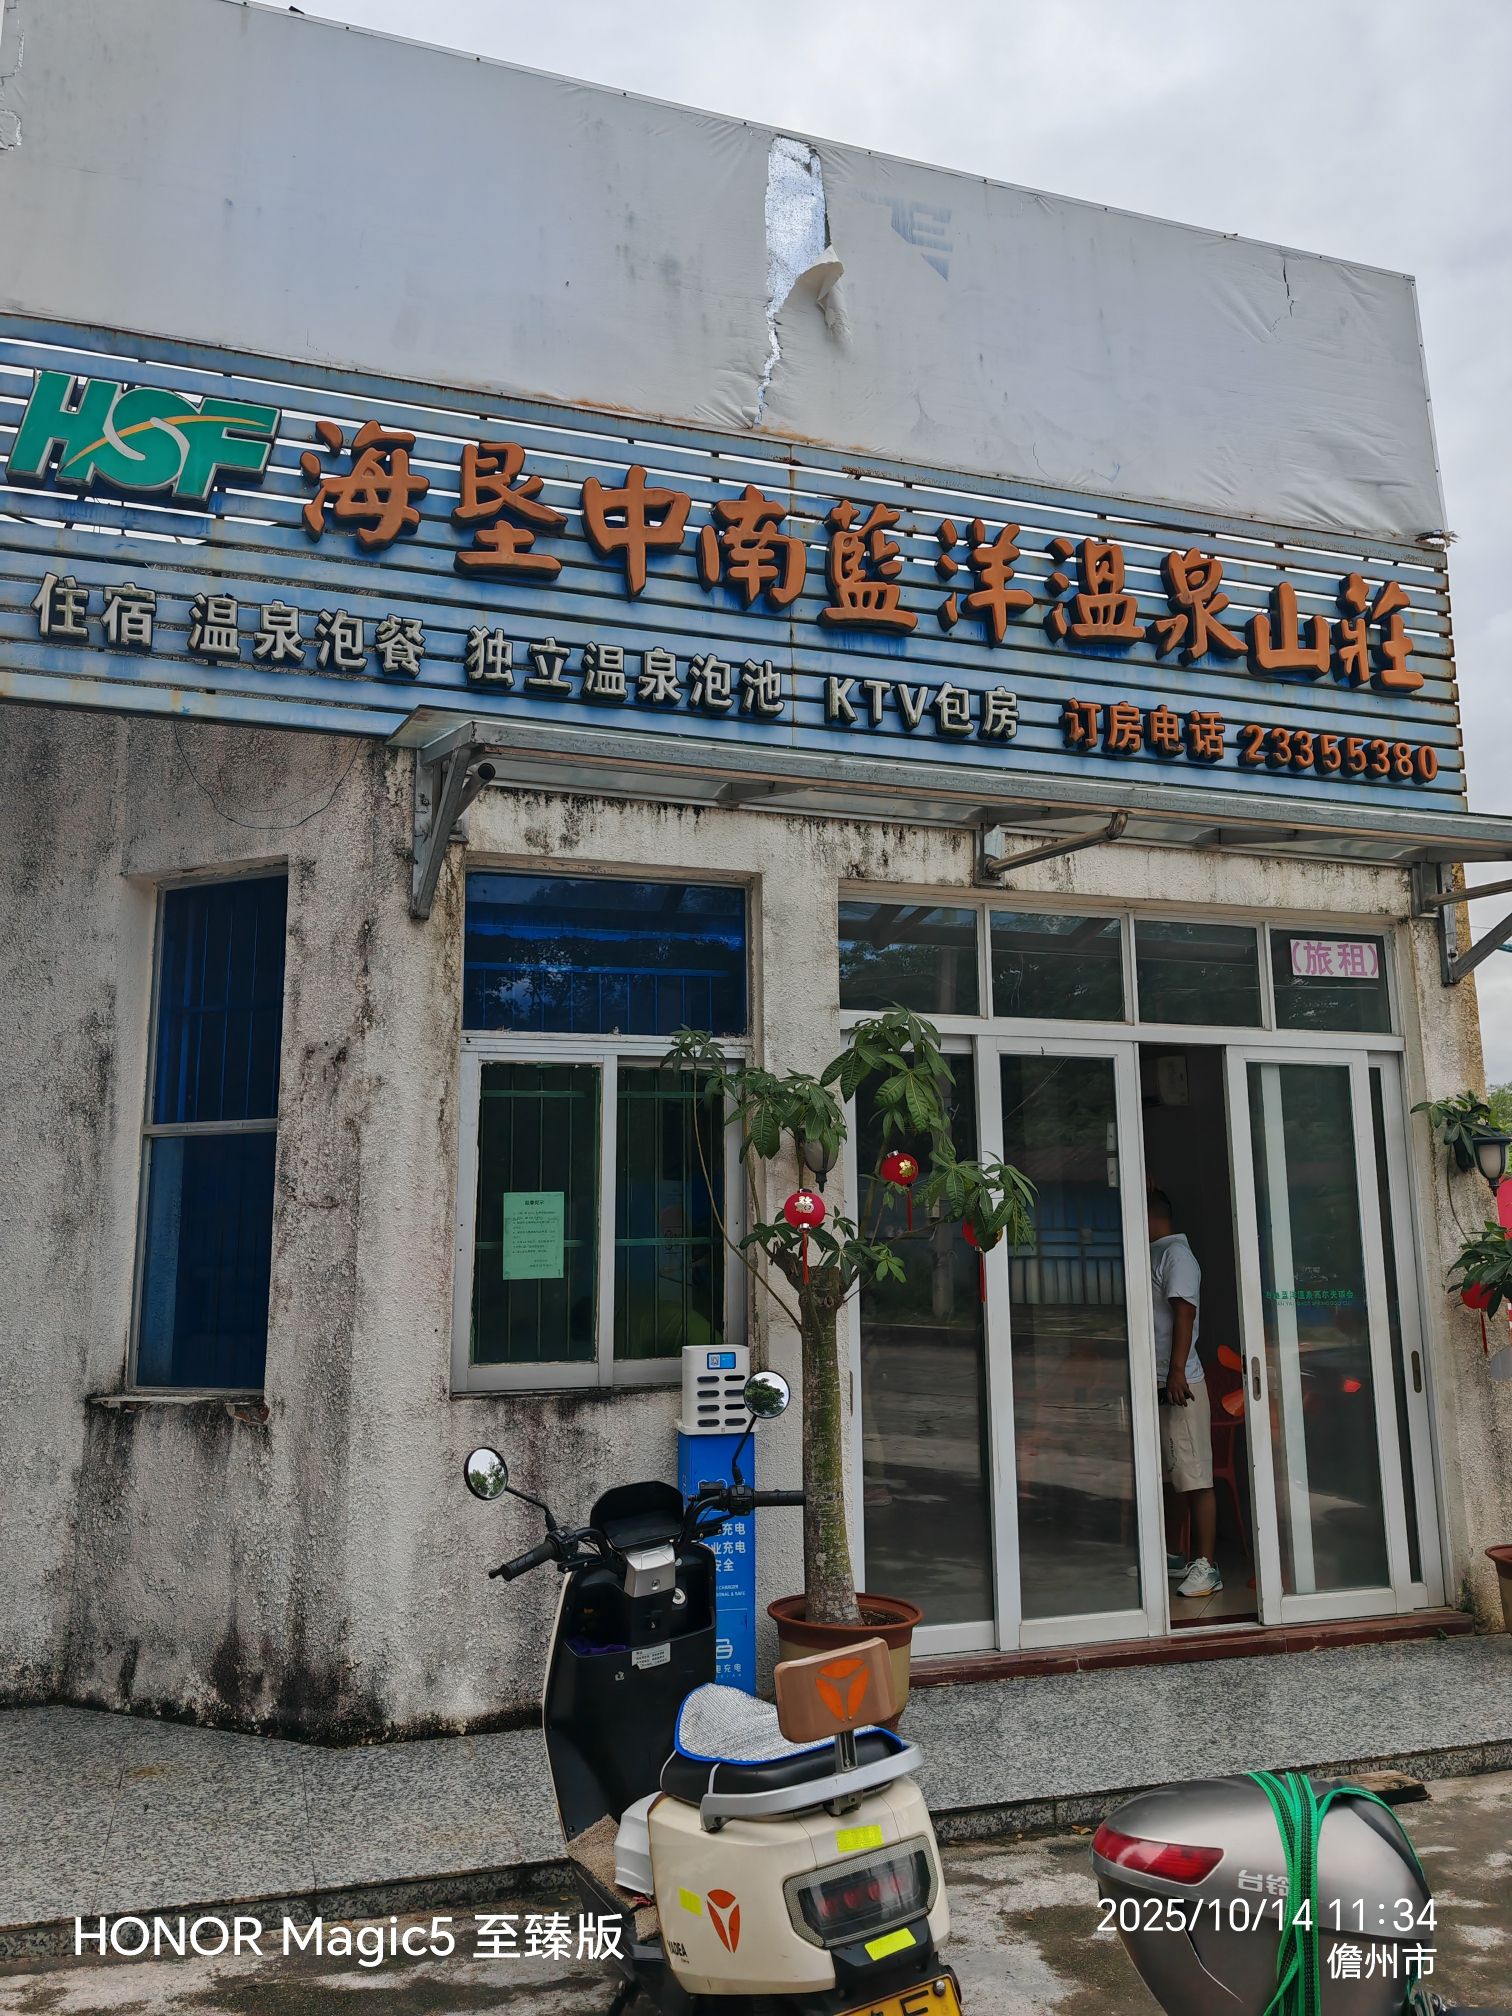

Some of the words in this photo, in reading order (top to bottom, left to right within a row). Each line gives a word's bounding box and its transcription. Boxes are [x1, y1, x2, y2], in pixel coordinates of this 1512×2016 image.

[31, 571, 156, 648] 住宿
[188, 592, 425, 677] 温泉泡餐
[465, 625, 785, 717] 独立温泉泡池
[824, 676, 1019, 741] KTV包房
[1062, 698, 1226, 764] 订房电话
[1238, 724, 1438, 784] 23355380
